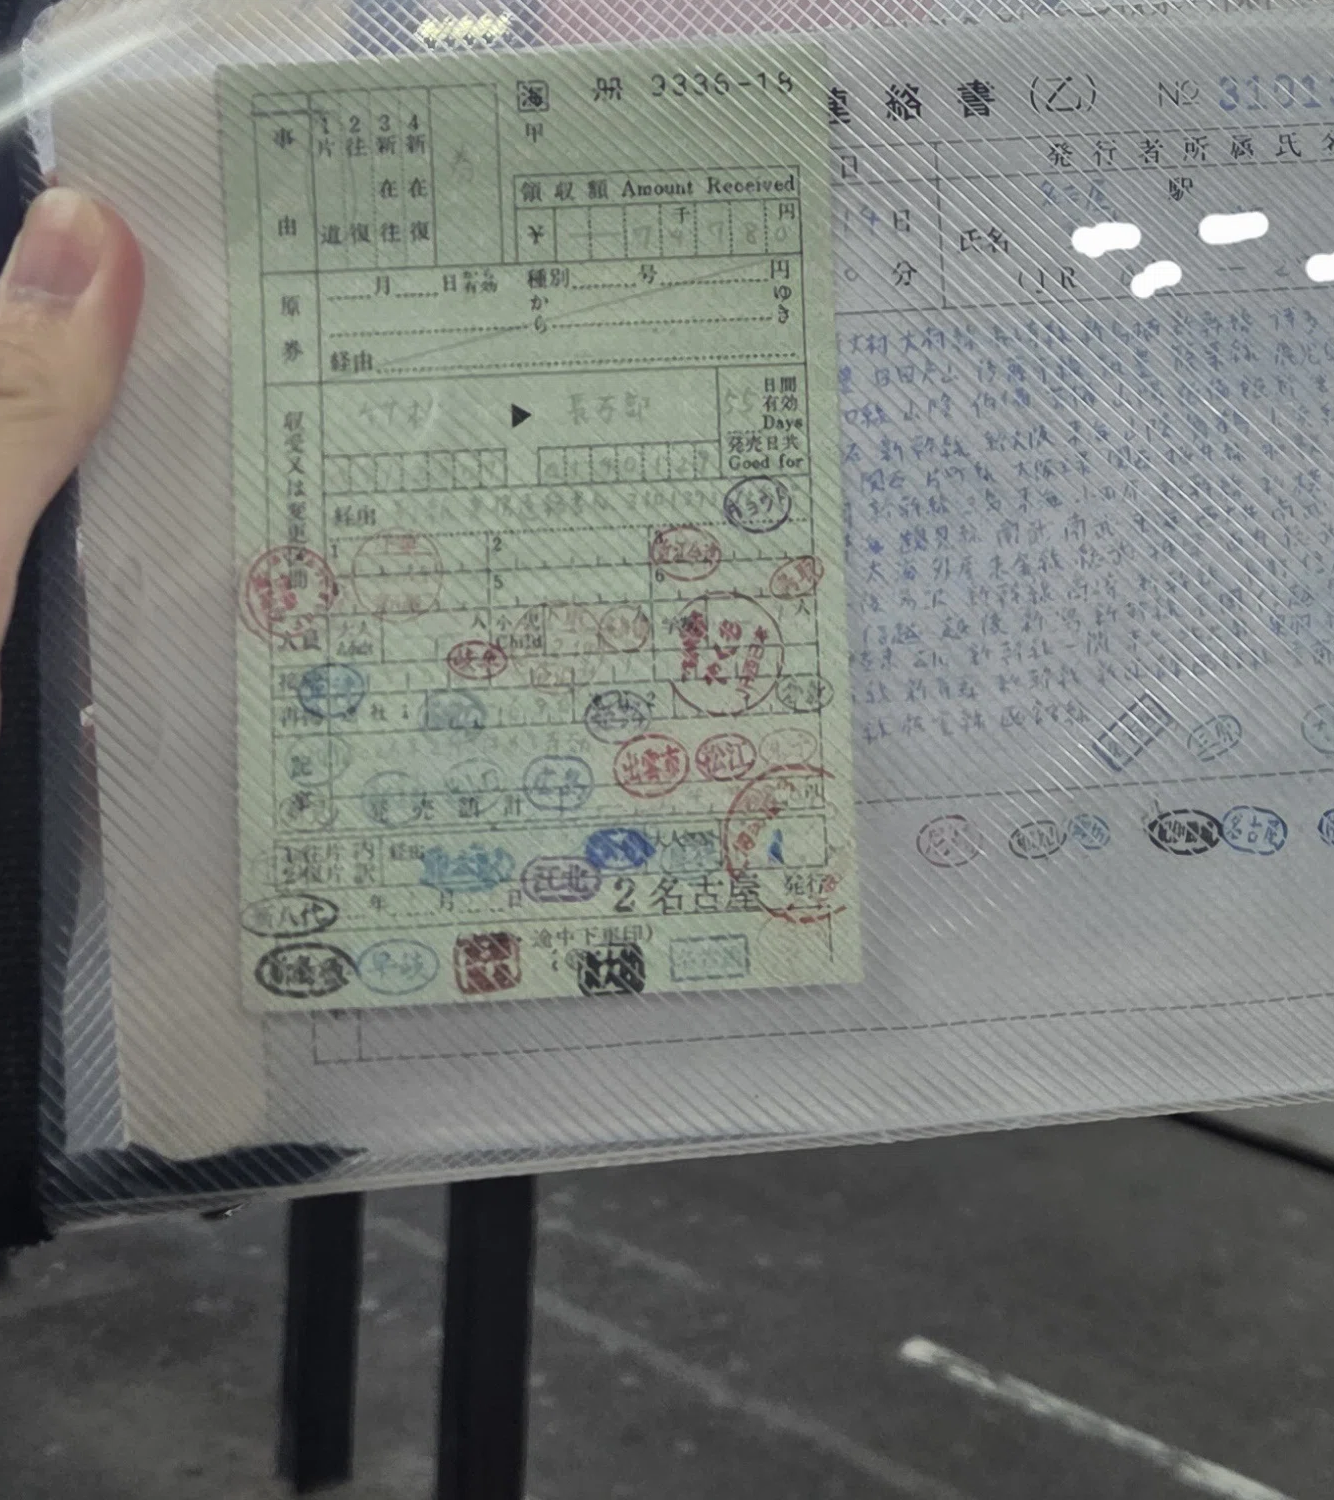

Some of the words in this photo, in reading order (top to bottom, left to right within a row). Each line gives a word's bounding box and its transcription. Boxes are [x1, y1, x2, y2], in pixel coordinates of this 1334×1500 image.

[520, 179, 610, 202] 領収額
[621, 179, 694, 199] Amount
[706, 174, 796, 194] Received
[892, 208, 911, 234] 日
[959, 227, 1010, 255] 氏名
[892, 259, 918, 287] 分
[762, 413, 804, 432] Days
[728, 455, 770, 471] Good
[777, 454, 805, 470] for
